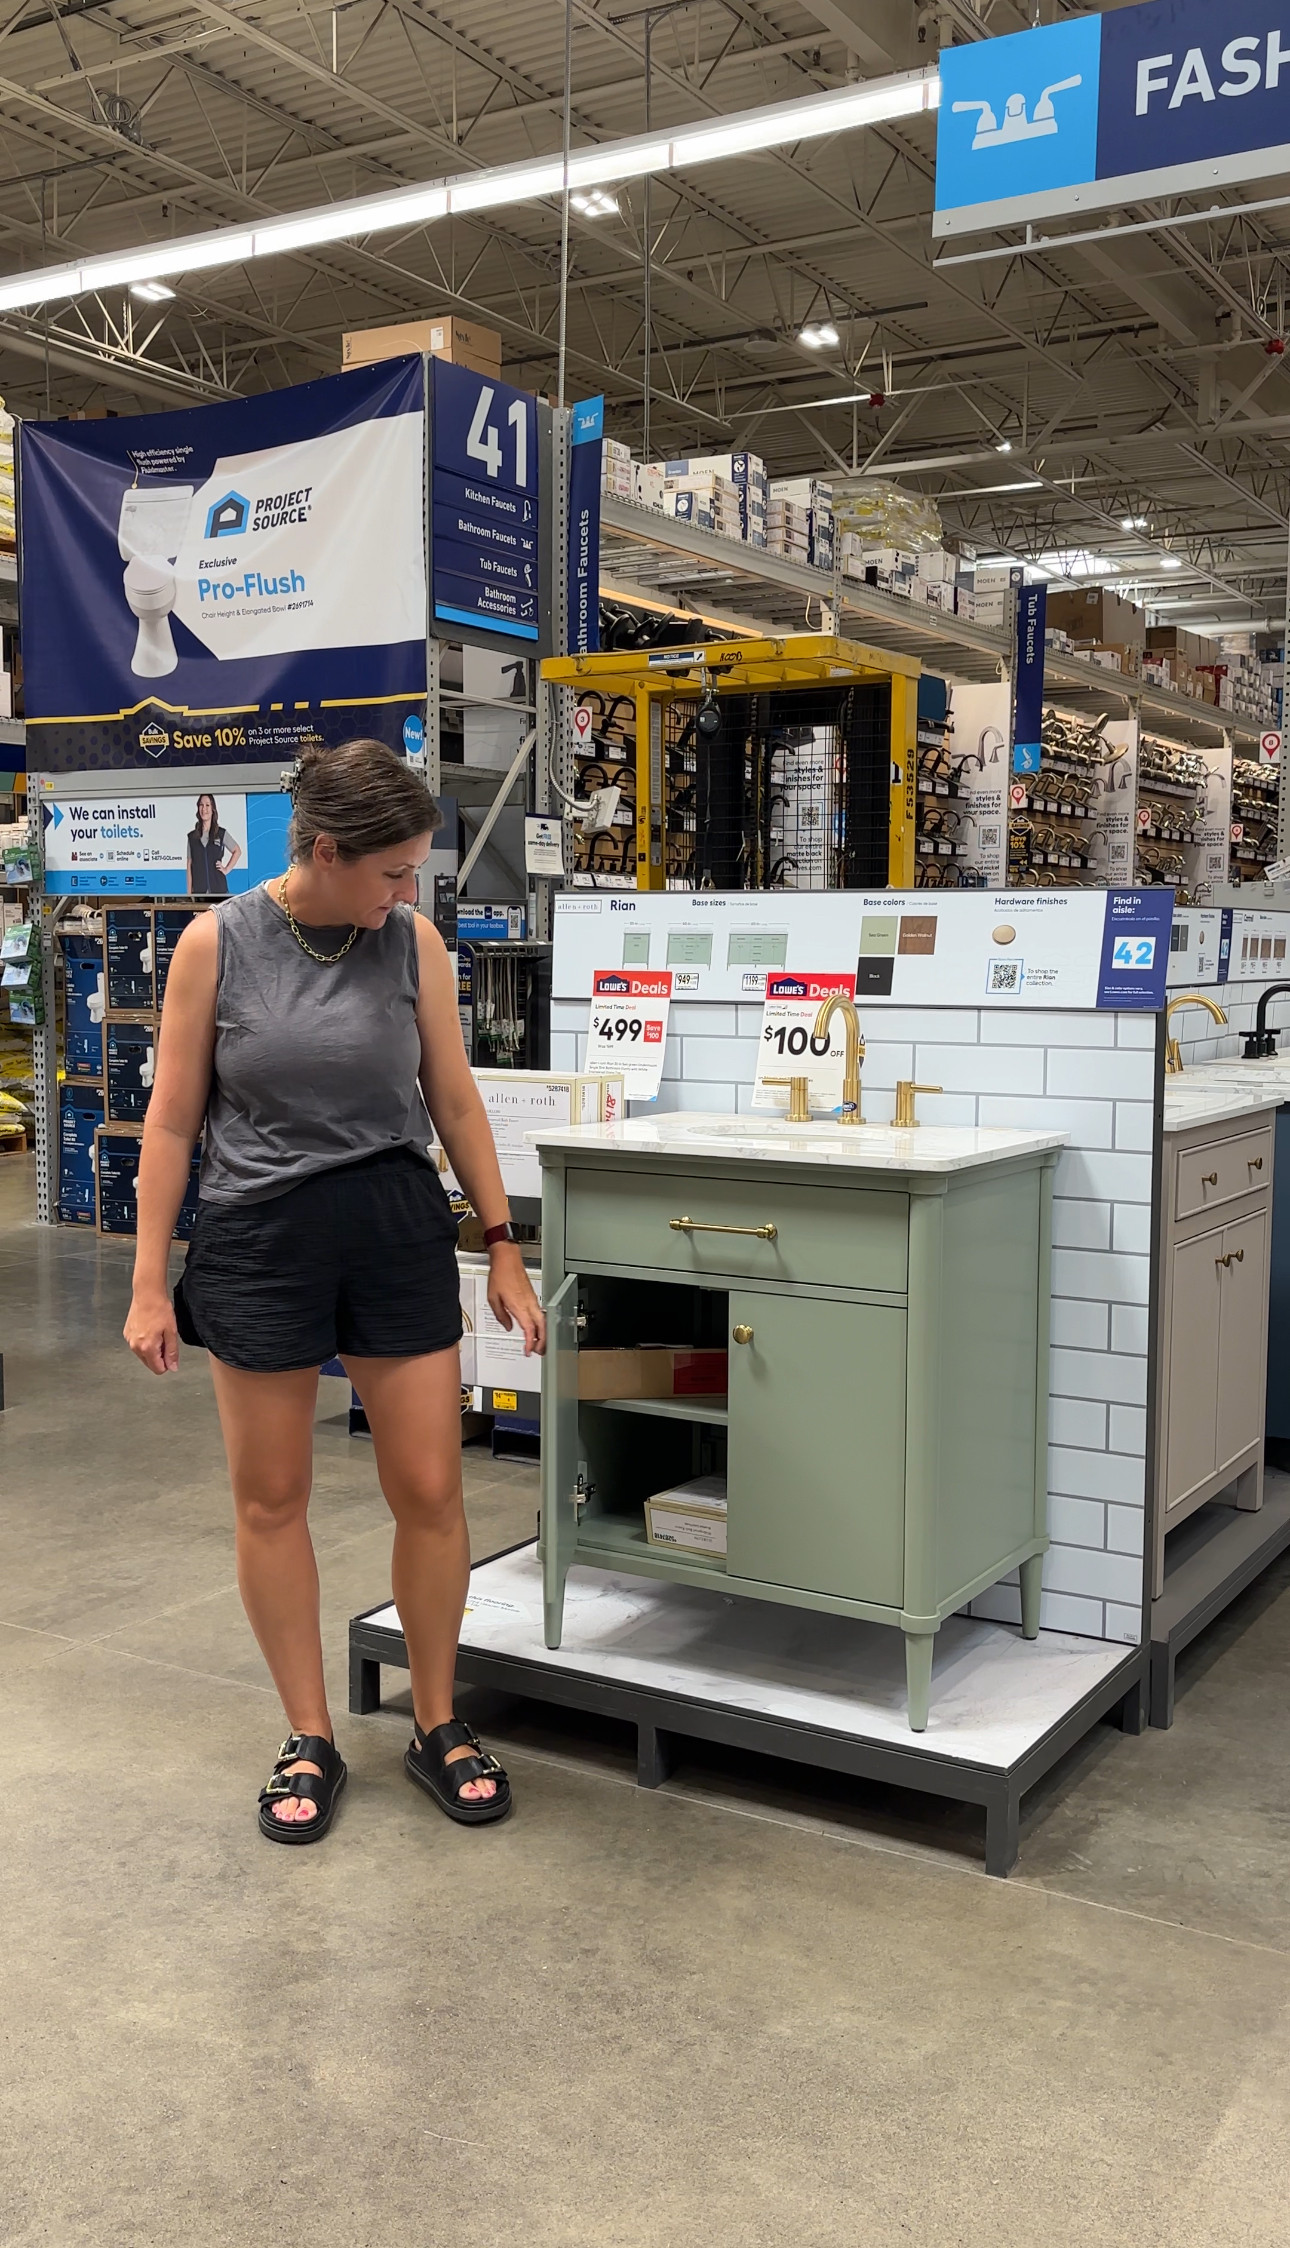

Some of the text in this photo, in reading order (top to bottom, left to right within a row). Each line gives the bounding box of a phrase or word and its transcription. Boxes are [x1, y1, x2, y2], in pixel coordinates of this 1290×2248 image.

[1135, 29, 1290, 116] FASH
[466, 385, 527, 488] 41
[146, 448, 174, 458] efficiency
[175, 445, 194, 456] single
[150, 457, 176, 466] powered
[176, 456, 186, 465] by
[255, 487, 312, 514] PROJECT
[465, 488, 516, 514] Kitchen Faucets
[458, 520, 516, 546] Bathroom Faucets
[198, 556, 238, 570] Exclusive
[480, 557, 518, 577] Tub Faucets
[866, 558, 883, 566] MOEN
[198, 569, 306, 602] Pro-Flush
[578, 509, 590, 656] athroom Faucets
[484, 586, 516, 603] Bathroom
[202, 600, 314, 620] Chair Height & Elongated Bowl #2691714
[477, 597, 516, 616] Accessories
[1026, 594, 1038, 665] Tub Faucets
[148, 728, 158, 736] Bulk
[248, 728, 258, 736] on
[258, 726, 264, 735] 3
[273, 726, 292, 734] more
[292, 724, 314, 733] select
[405, 727, 423, 740] New!
[142, 736, 166, 745] SAVINGS
[172, 727, 246, 749] Save 10%
[248, 734, 325, 747] Project Source toilets.
[794, 766, 818, 774] styles
[812, 774, 824, 782] for
[798, 784, 822, 792] space.
[69, 804, 156, 821] We can install
[980, 808, 1001, 816] space.
[70, 824, 144, 842] your toilets.
[558, 902, 576, 910] allen
[582, 902, 598, 910] roth
[610, 900, 636, 912] Rian
[709, 899, 726, 907] sizes
[864, 897, 1068, 906] Base colors Hardware finishes
[1114, 896, 1142, 904] Find in
[475, 908, 504, 918] the app.
[1112, 906, 1136, 914] aisle:
[1114, 941, 1153, 965] 42
[678, 974, 691, 985] 949
[746, 975, 758, 986] 1199
[599, 980, 668, 994] LOWE'S Deals
[772, 984, 850, 998] LOWE'S Deals
[594, 1016, 642, 1042] $499
[646, 1024, 660, 1032] Save
[764, 1025, 831, 1056] $100
[488, 1092, 556, 1106] allen roth
